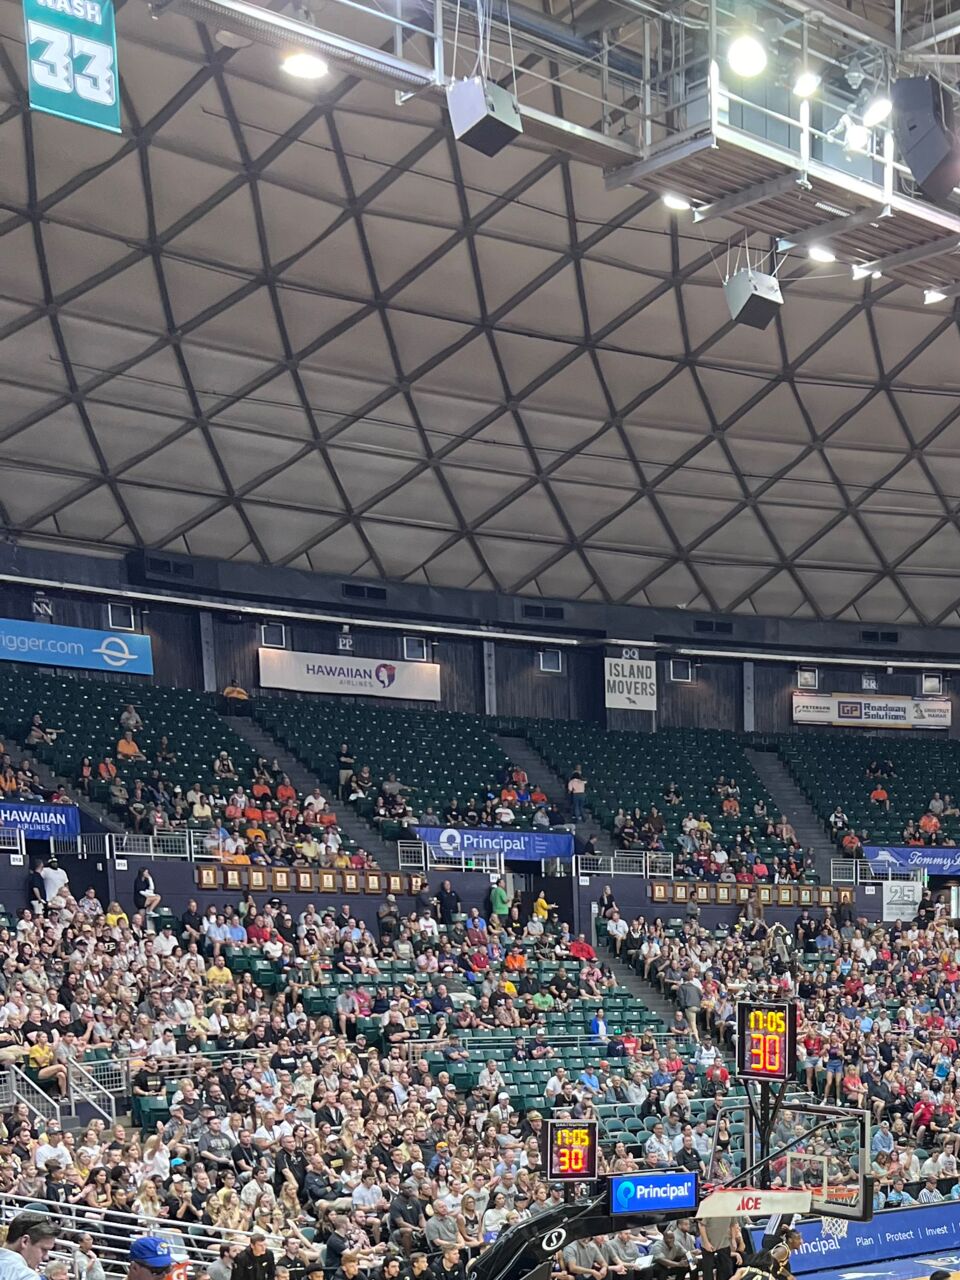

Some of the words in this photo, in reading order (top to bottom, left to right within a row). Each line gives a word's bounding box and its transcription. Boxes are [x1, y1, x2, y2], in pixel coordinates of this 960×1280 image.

[28, 20, 116, 106] 33
[0, 631, 84, 656] igger.com
[306, 664, 372, 679] HAWAIIAN
[609, 663, 652, 679] ISLAND
[339, 679, 373, 688] AIRLINES
[606, 679, 655, 696] MOVERS
[864, 703, 906, 714] Roadway
[864, 712, 906, 720] Solutions
[1, 810, 66, 824] HAWAIIAN
[17, 823, 51, 831] AIRLINES
[464, 834, 526, 852] Principal
[908, 851, 952, 870] Tommy
[750, 1010, 786, 1033] 17:05
[751, 1033, 779, 1070] 30
[556, 1129, 589, 1146] 17:05
[559, 1149, 583, 1172] 30
[637, 1183, 688, 1200] Principal
[736, 1196, 761, 1210] ACE
[795, 1235, 841, 1255] incipal
[856, 1236, 874, 1247] Plan
[886, 1231, 914, 1242] Protect
[926, 1224, 948, 1236] Invest
